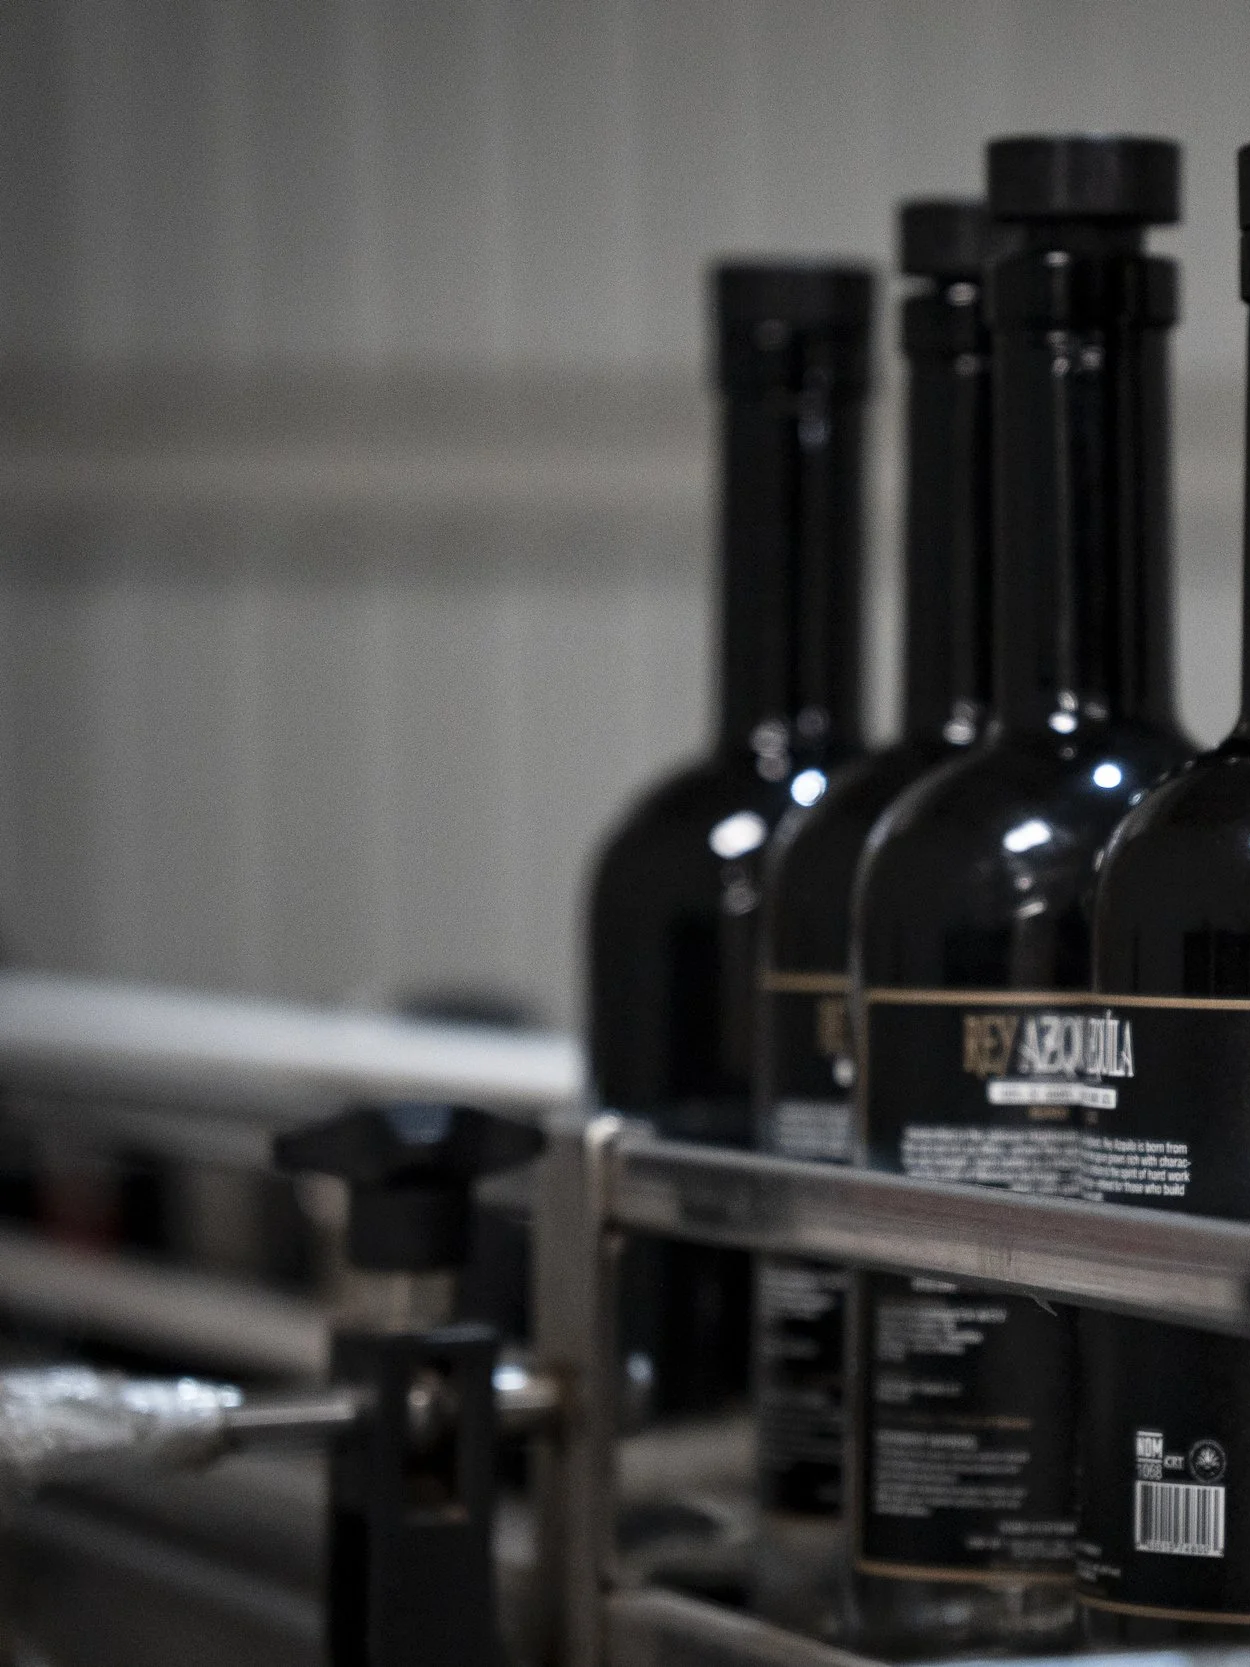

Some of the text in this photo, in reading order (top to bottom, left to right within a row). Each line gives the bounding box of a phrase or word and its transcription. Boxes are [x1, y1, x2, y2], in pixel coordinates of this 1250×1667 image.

[1145, 1141, 1165, 1154] born
[1166, 1142, 1188, 1154] from
[1141, 1155, 1158, 1167] with
[1147, 1169, 1166, 1181] hard
[1168, 1171, 1190, 1182] work
[1145, 1183, 1162, 1195] who
[1163, 1183, 1185, 1197] build
[1136, 1437, 1163, 1459] NOM
[1164, 1455, 1184, 1470] CRT
